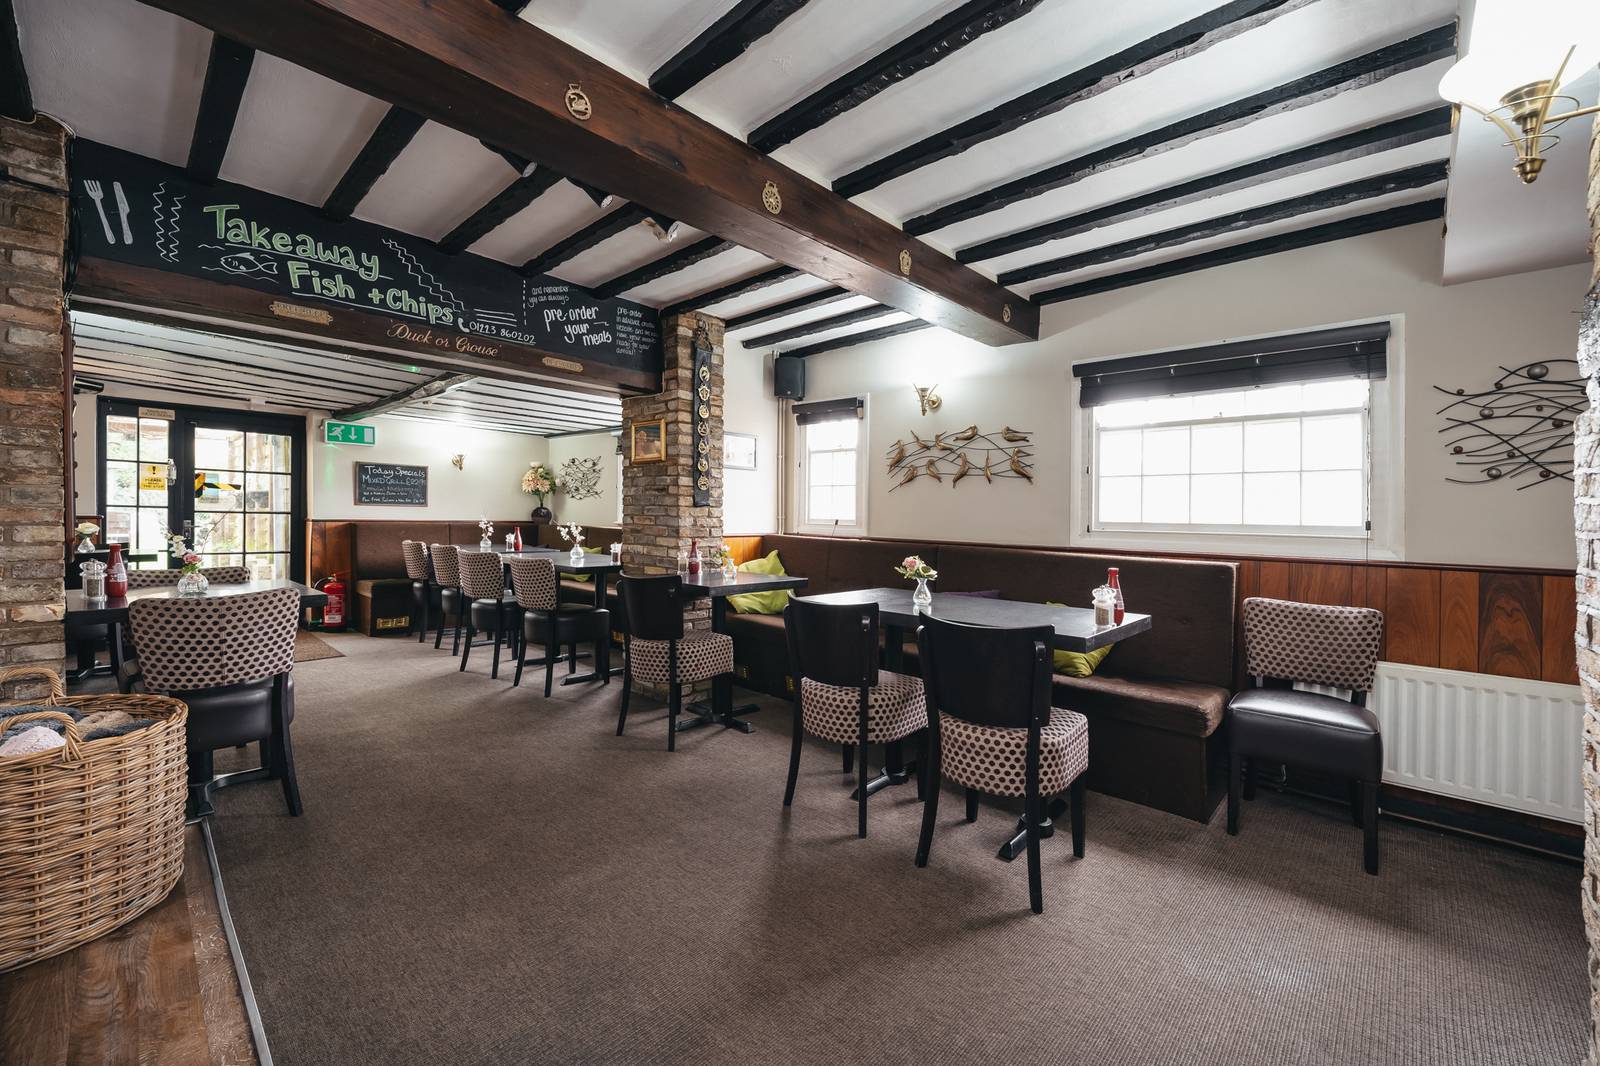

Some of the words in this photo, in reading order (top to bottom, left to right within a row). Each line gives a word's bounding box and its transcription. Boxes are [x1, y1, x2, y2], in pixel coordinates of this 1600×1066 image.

[203, 204, 379, 281] Takeaway
[287, 261, 355, 299] Fish
[435, 336, 449, 347] or
[469, 321, 496, 334] 01223
[500, 328, 536, 344] 860202
[564, 322, 590, 343] your
[582, 331, 612, 346] meals
[364, 465, 394, 478] Today
[395, 466, 425, 478] Specials
